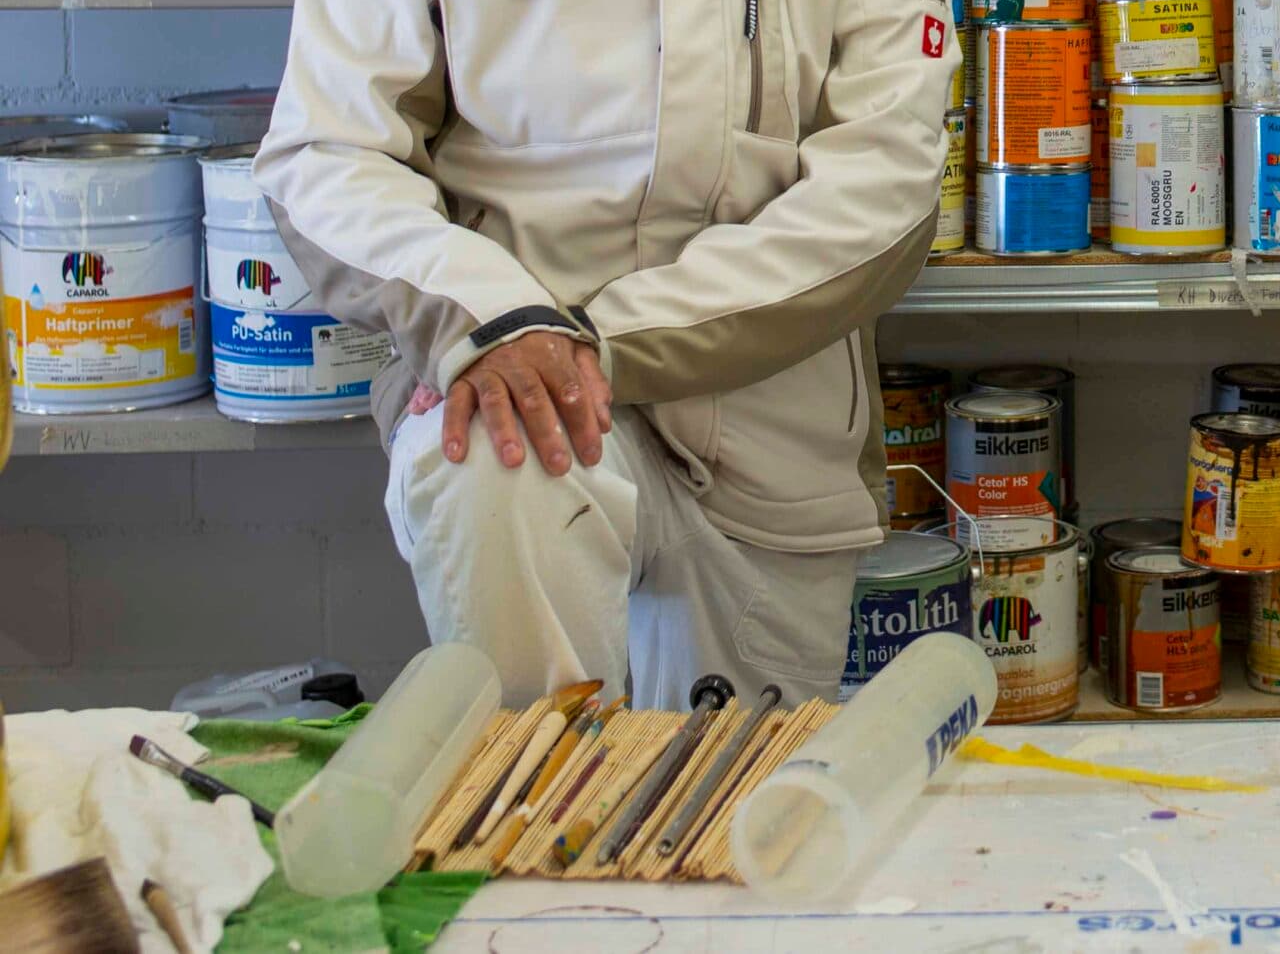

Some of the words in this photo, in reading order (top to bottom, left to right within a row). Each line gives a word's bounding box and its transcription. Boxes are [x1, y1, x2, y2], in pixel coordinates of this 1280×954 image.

[1154, 4, 1199, 13] SATINA
[1151, 180, 1160, 225] RAL6005
[1163, 170, 1172, 225] MOOSGRU
[1175, 210, 1184, 225] EN
[67, 288, 109, 297] CAPAROL
[46, 317, 134, 331] Haftprimer
[232, 328, 292, 342] PU-Satin
[63, 432, 90, 449] WV
[976, 437, 1049, 455] sikkens
[1013, 477, 1028, 486] HS
[979, 489, 1007, 499] Color
[985, 644, 1037, 656] CAPAROL
